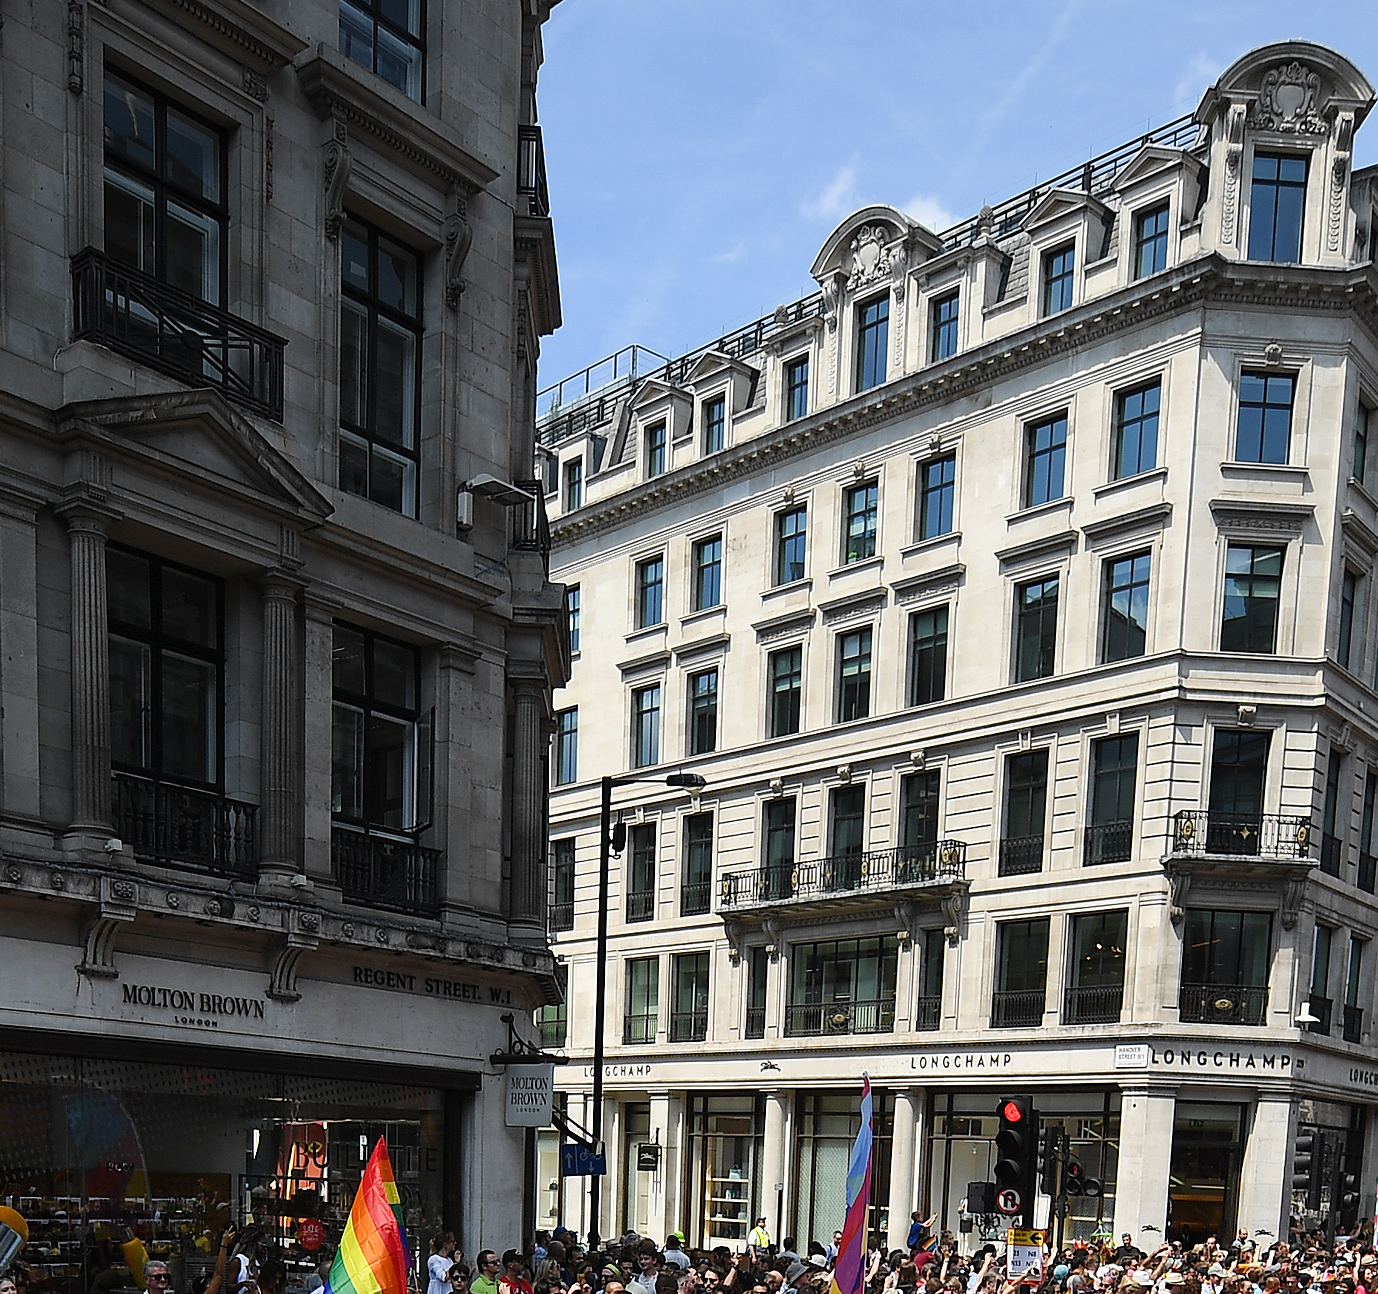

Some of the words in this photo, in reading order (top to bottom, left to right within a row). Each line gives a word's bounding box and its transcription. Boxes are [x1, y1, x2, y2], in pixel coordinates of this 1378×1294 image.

[353, 966, 416, 991] REGENT
[123, 982, 196, 1012] MOLTON
[199, 994, 265, 1019] BROWN
[175, 1015, 218, 1027] LONDON
[911, 1055, 1011, 1069] LONGCHAMP
[1151, 1049, 1291, 1070] LONGCHAMP
[584, 1065, 651, 1078] LOGCHAMP
[511, 1077, 549, 1090] MOLTON
[511, 1092, 548, 1106] BROWN
